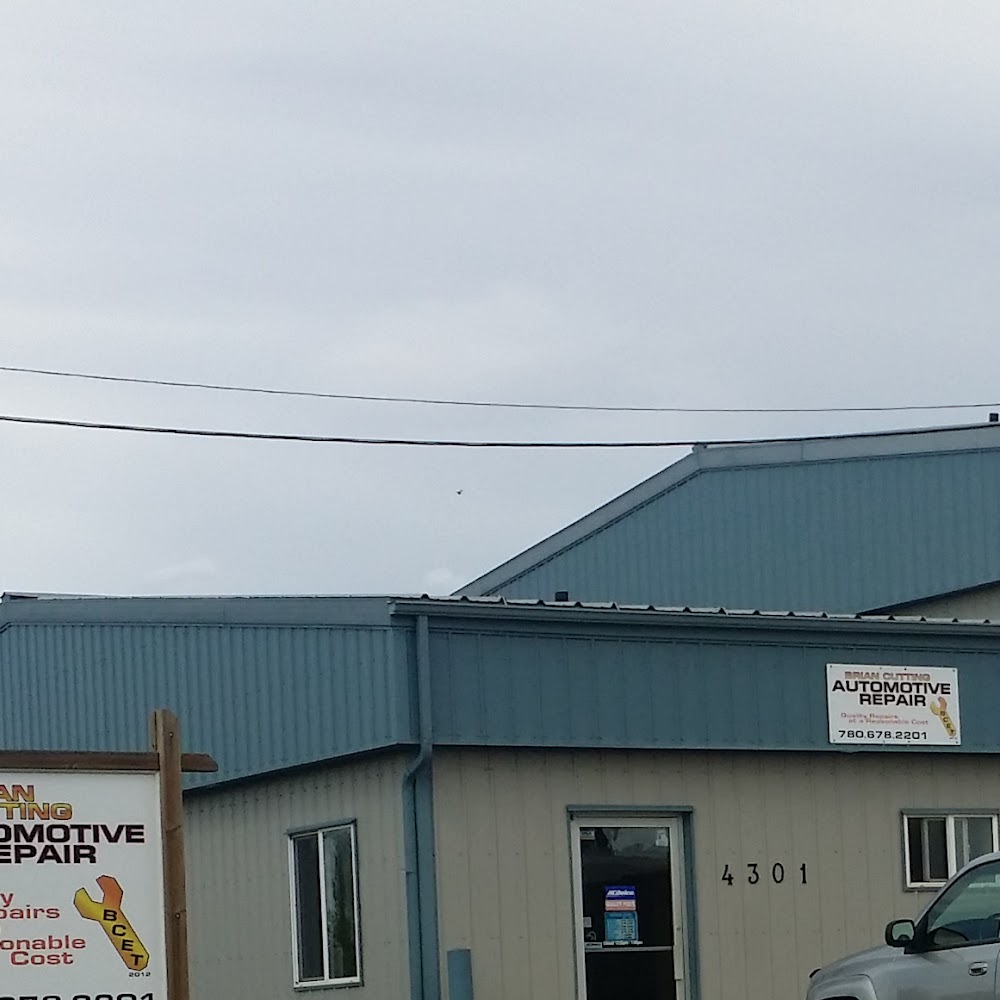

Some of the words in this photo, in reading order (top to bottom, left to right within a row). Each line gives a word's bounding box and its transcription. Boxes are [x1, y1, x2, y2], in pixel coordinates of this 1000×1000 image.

[844, 671, 880, 681] BRIAN
[882, 672, 931, 682] CUTTING
[832, 680, 951, 695] AUTOMOTIVE
[859, 693, 927, 707] REPAIR
[838, 730, 928, 740] 780.678.2201
[0, 844, 97, 864] EPAIR
[721, 862, 807, 886] 4301
[0, 935, 86, 950] onable
[11, 951, 74, 965] Cost
